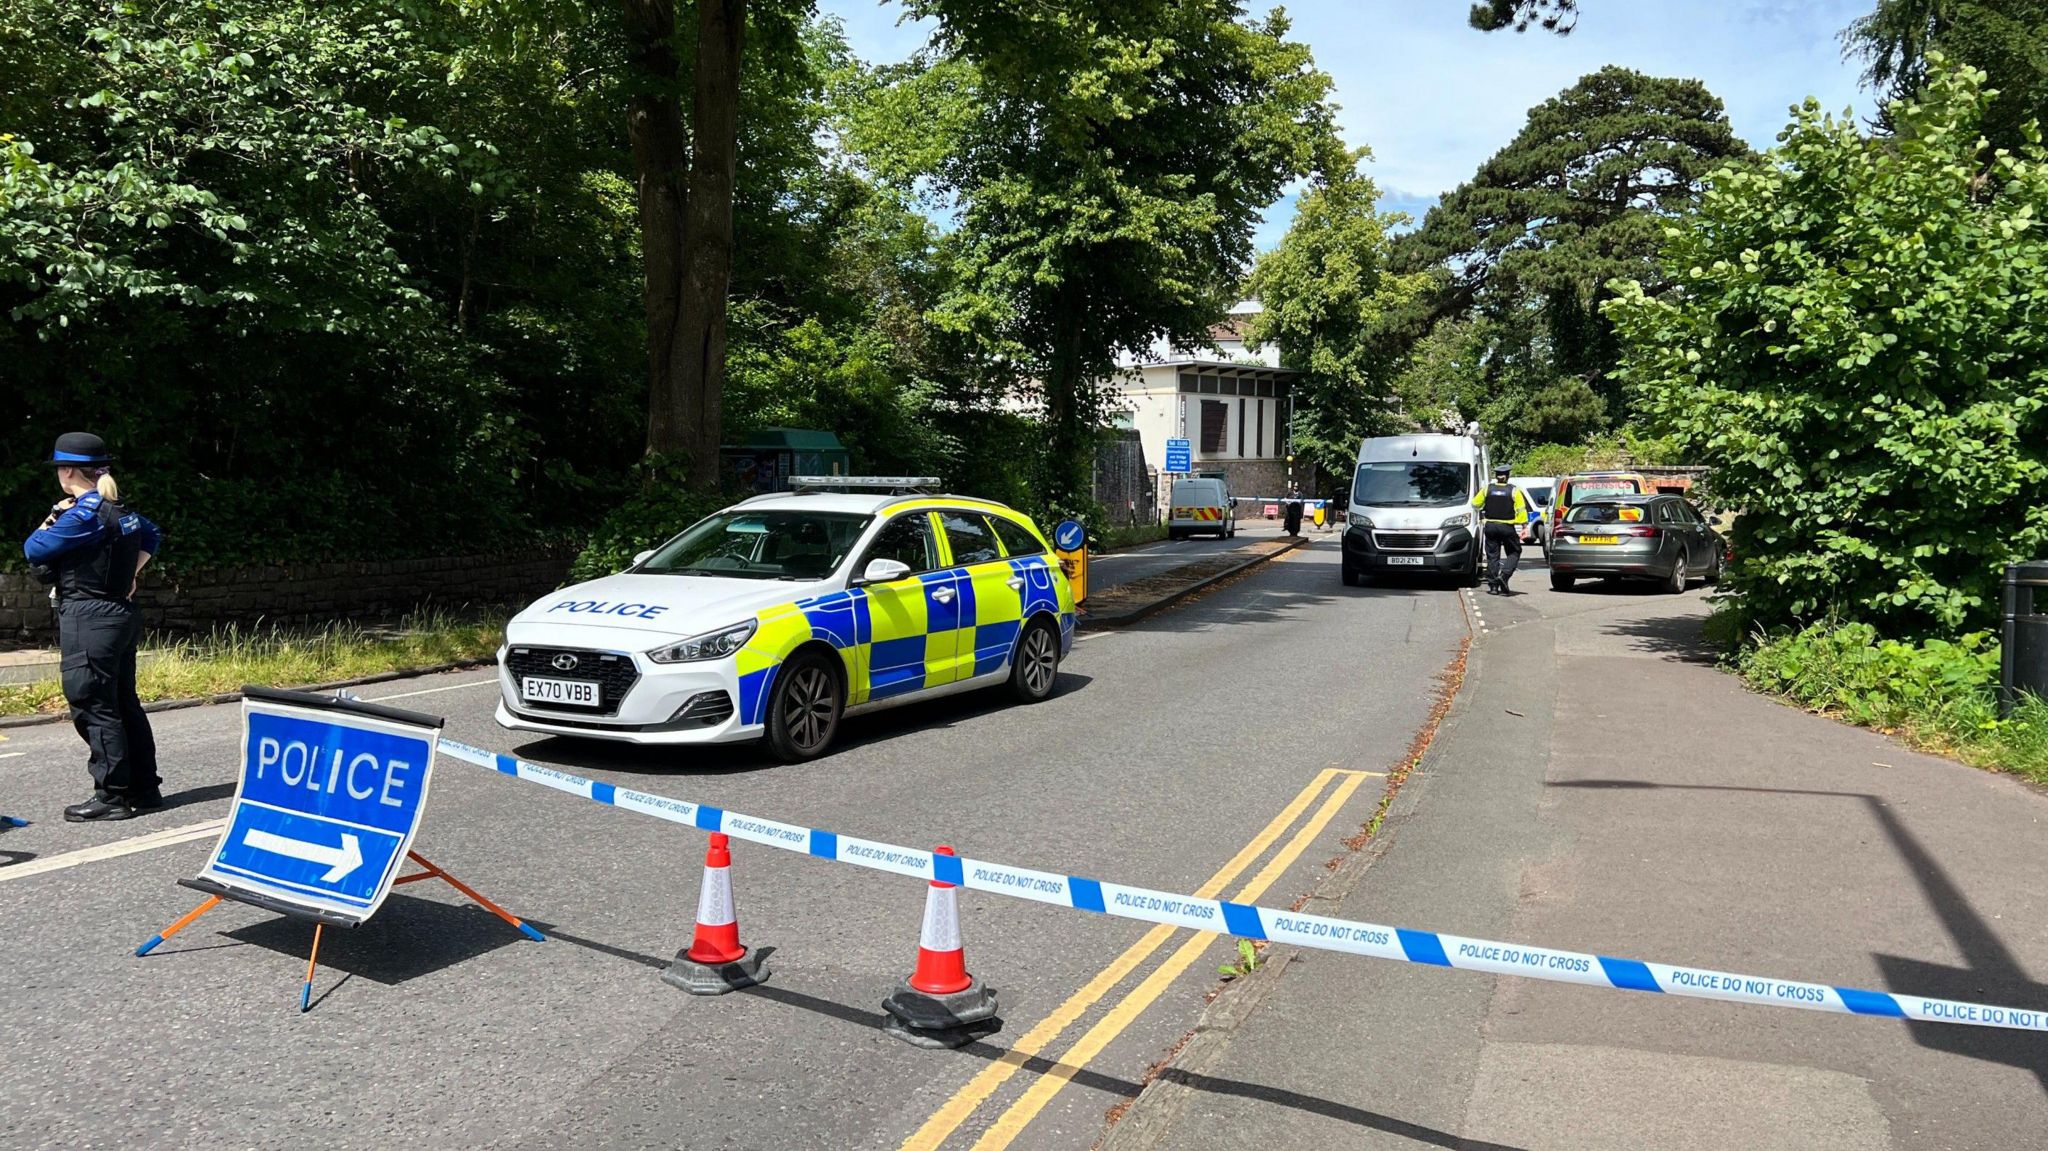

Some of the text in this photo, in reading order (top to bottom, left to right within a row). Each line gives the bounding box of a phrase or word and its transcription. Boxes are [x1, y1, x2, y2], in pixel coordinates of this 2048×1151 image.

[547, 601, 669, 619] POLICE
[528, 680, 592, 702] EX70 VBB
[257, 736, 410, 807] POLICE
[622, 790, 693, 815] POLICE DO NOT CROSS
[729, 818, 805, 843] POLICE DO NOT CROSS
[846, 845, 928, 868] POLICE DO NOT CROSS
[973, 869, 1063, 894] POLICE DO NOT CROSS
[1115, 893, 1215, 919] POLICE DO NOT CROSS
[1275, 918, 1389, 945] POLICE DO NOT CROSS
[1460, 944, 1589, 973] POLICE DO NOT CROSS
[1672, 971, 1824, 1002] POLICE DO NOT CROSS
[1923, 1001, 1978, 1020] POLICE
[1982, 1008, 2004, 1023] DO
[2009, 1012, 2041, 1027] NOT
